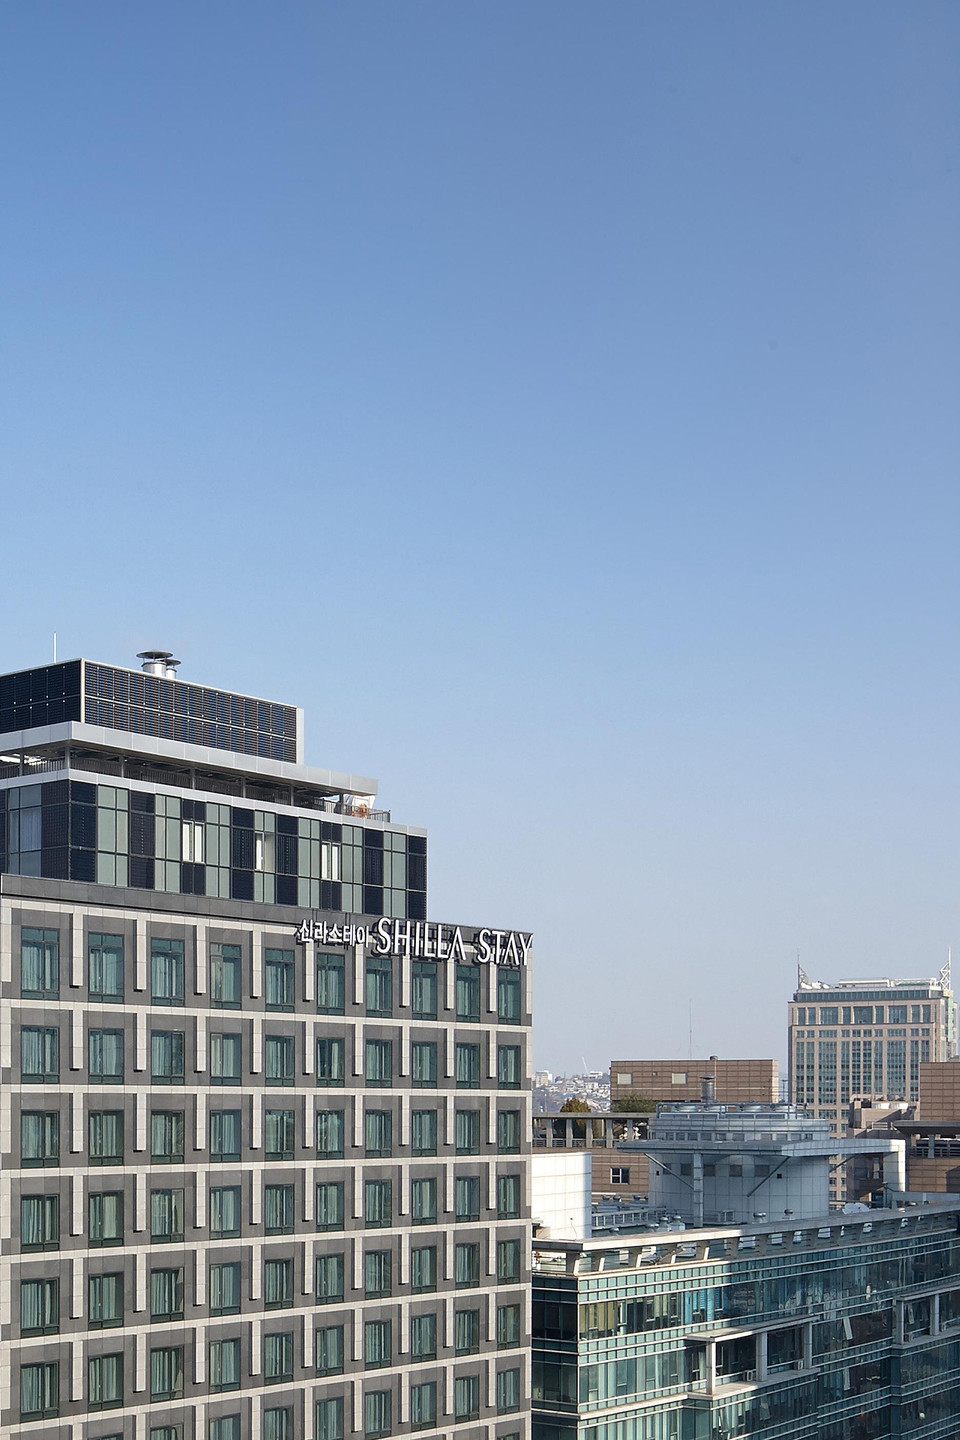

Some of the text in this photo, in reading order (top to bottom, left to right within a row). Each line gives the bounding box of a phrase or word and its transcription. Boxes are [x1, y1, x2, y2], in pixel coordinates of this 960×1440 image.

[299, 919, 370, 948] 신라스테이
[376, 917, 534, 967] SHILLA STAY
